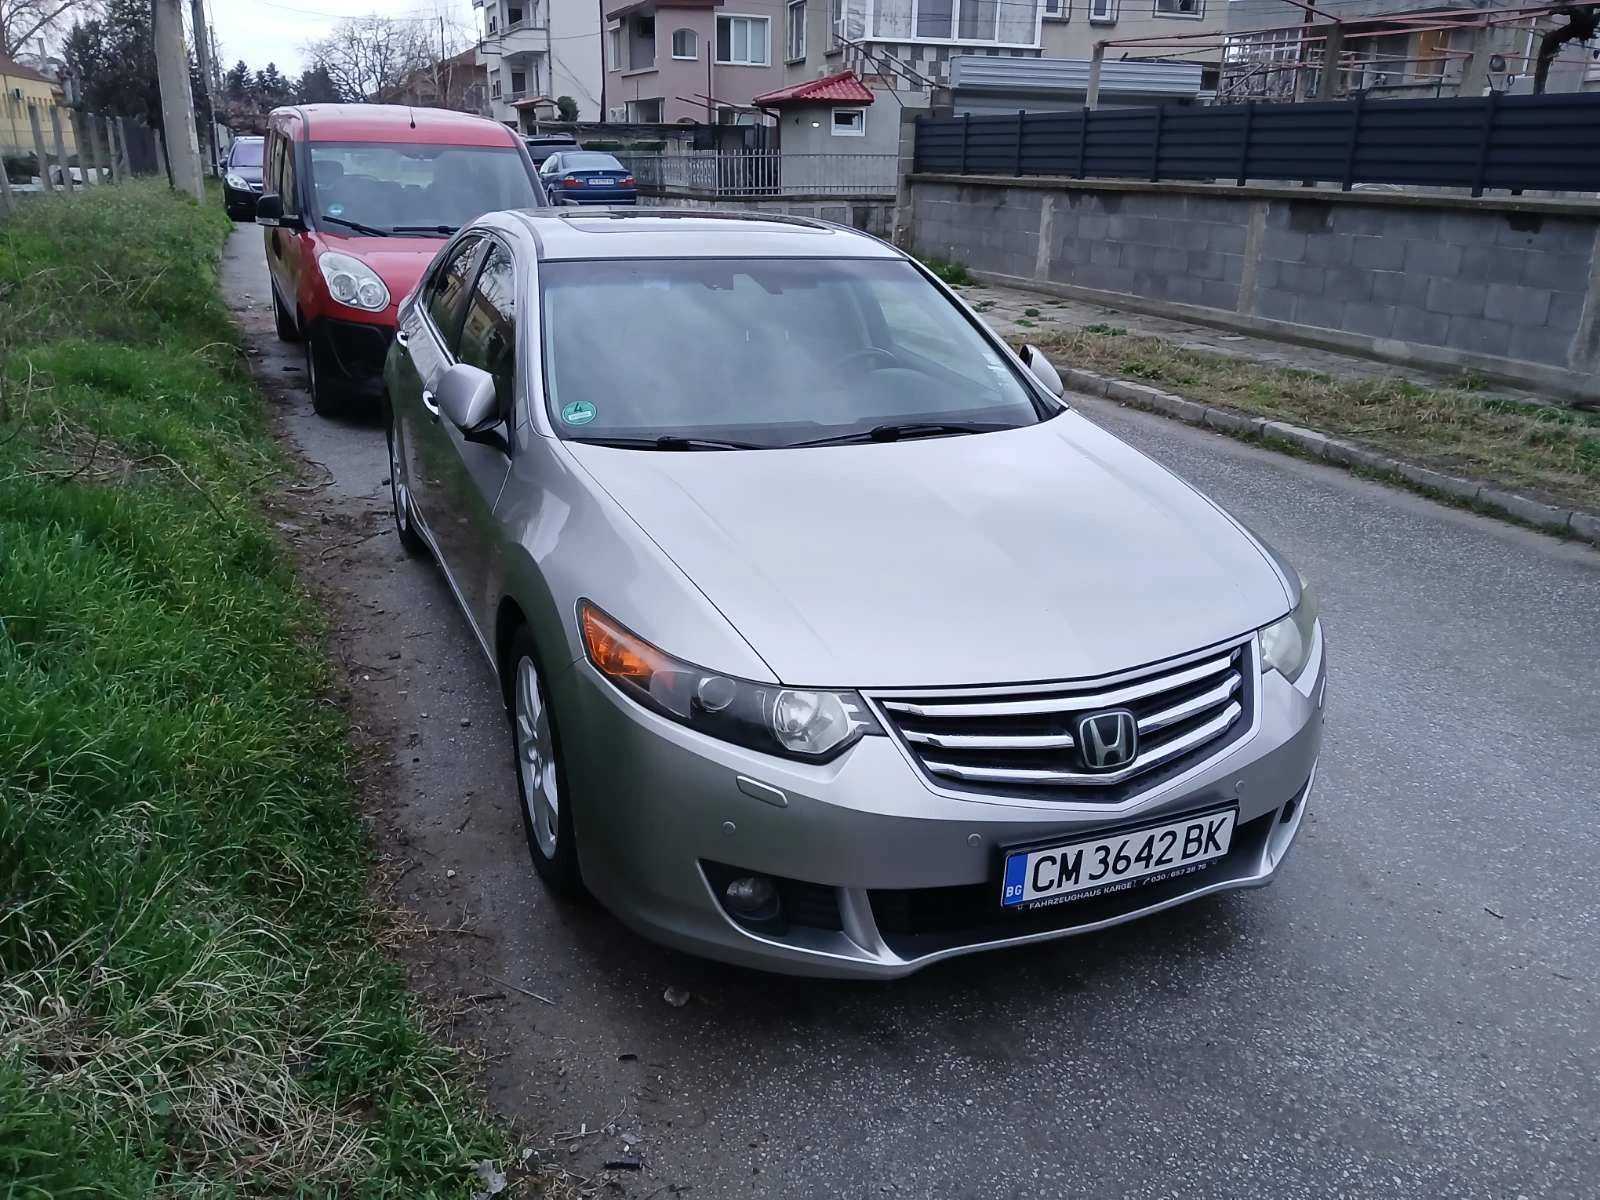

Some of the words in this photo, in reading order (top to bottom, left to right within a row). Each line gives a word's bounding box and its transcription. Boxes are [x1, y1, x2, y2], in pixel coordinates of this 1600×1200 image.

[1032, 849, 1084, 893] CM
[1088, 830, 1177, 881] 3642
[1181, 817, 1227, 860] BK
[1005, 884, 1023, 898] BG
[1029, 889, 1102, 910] FAHRZEUGHAUS
